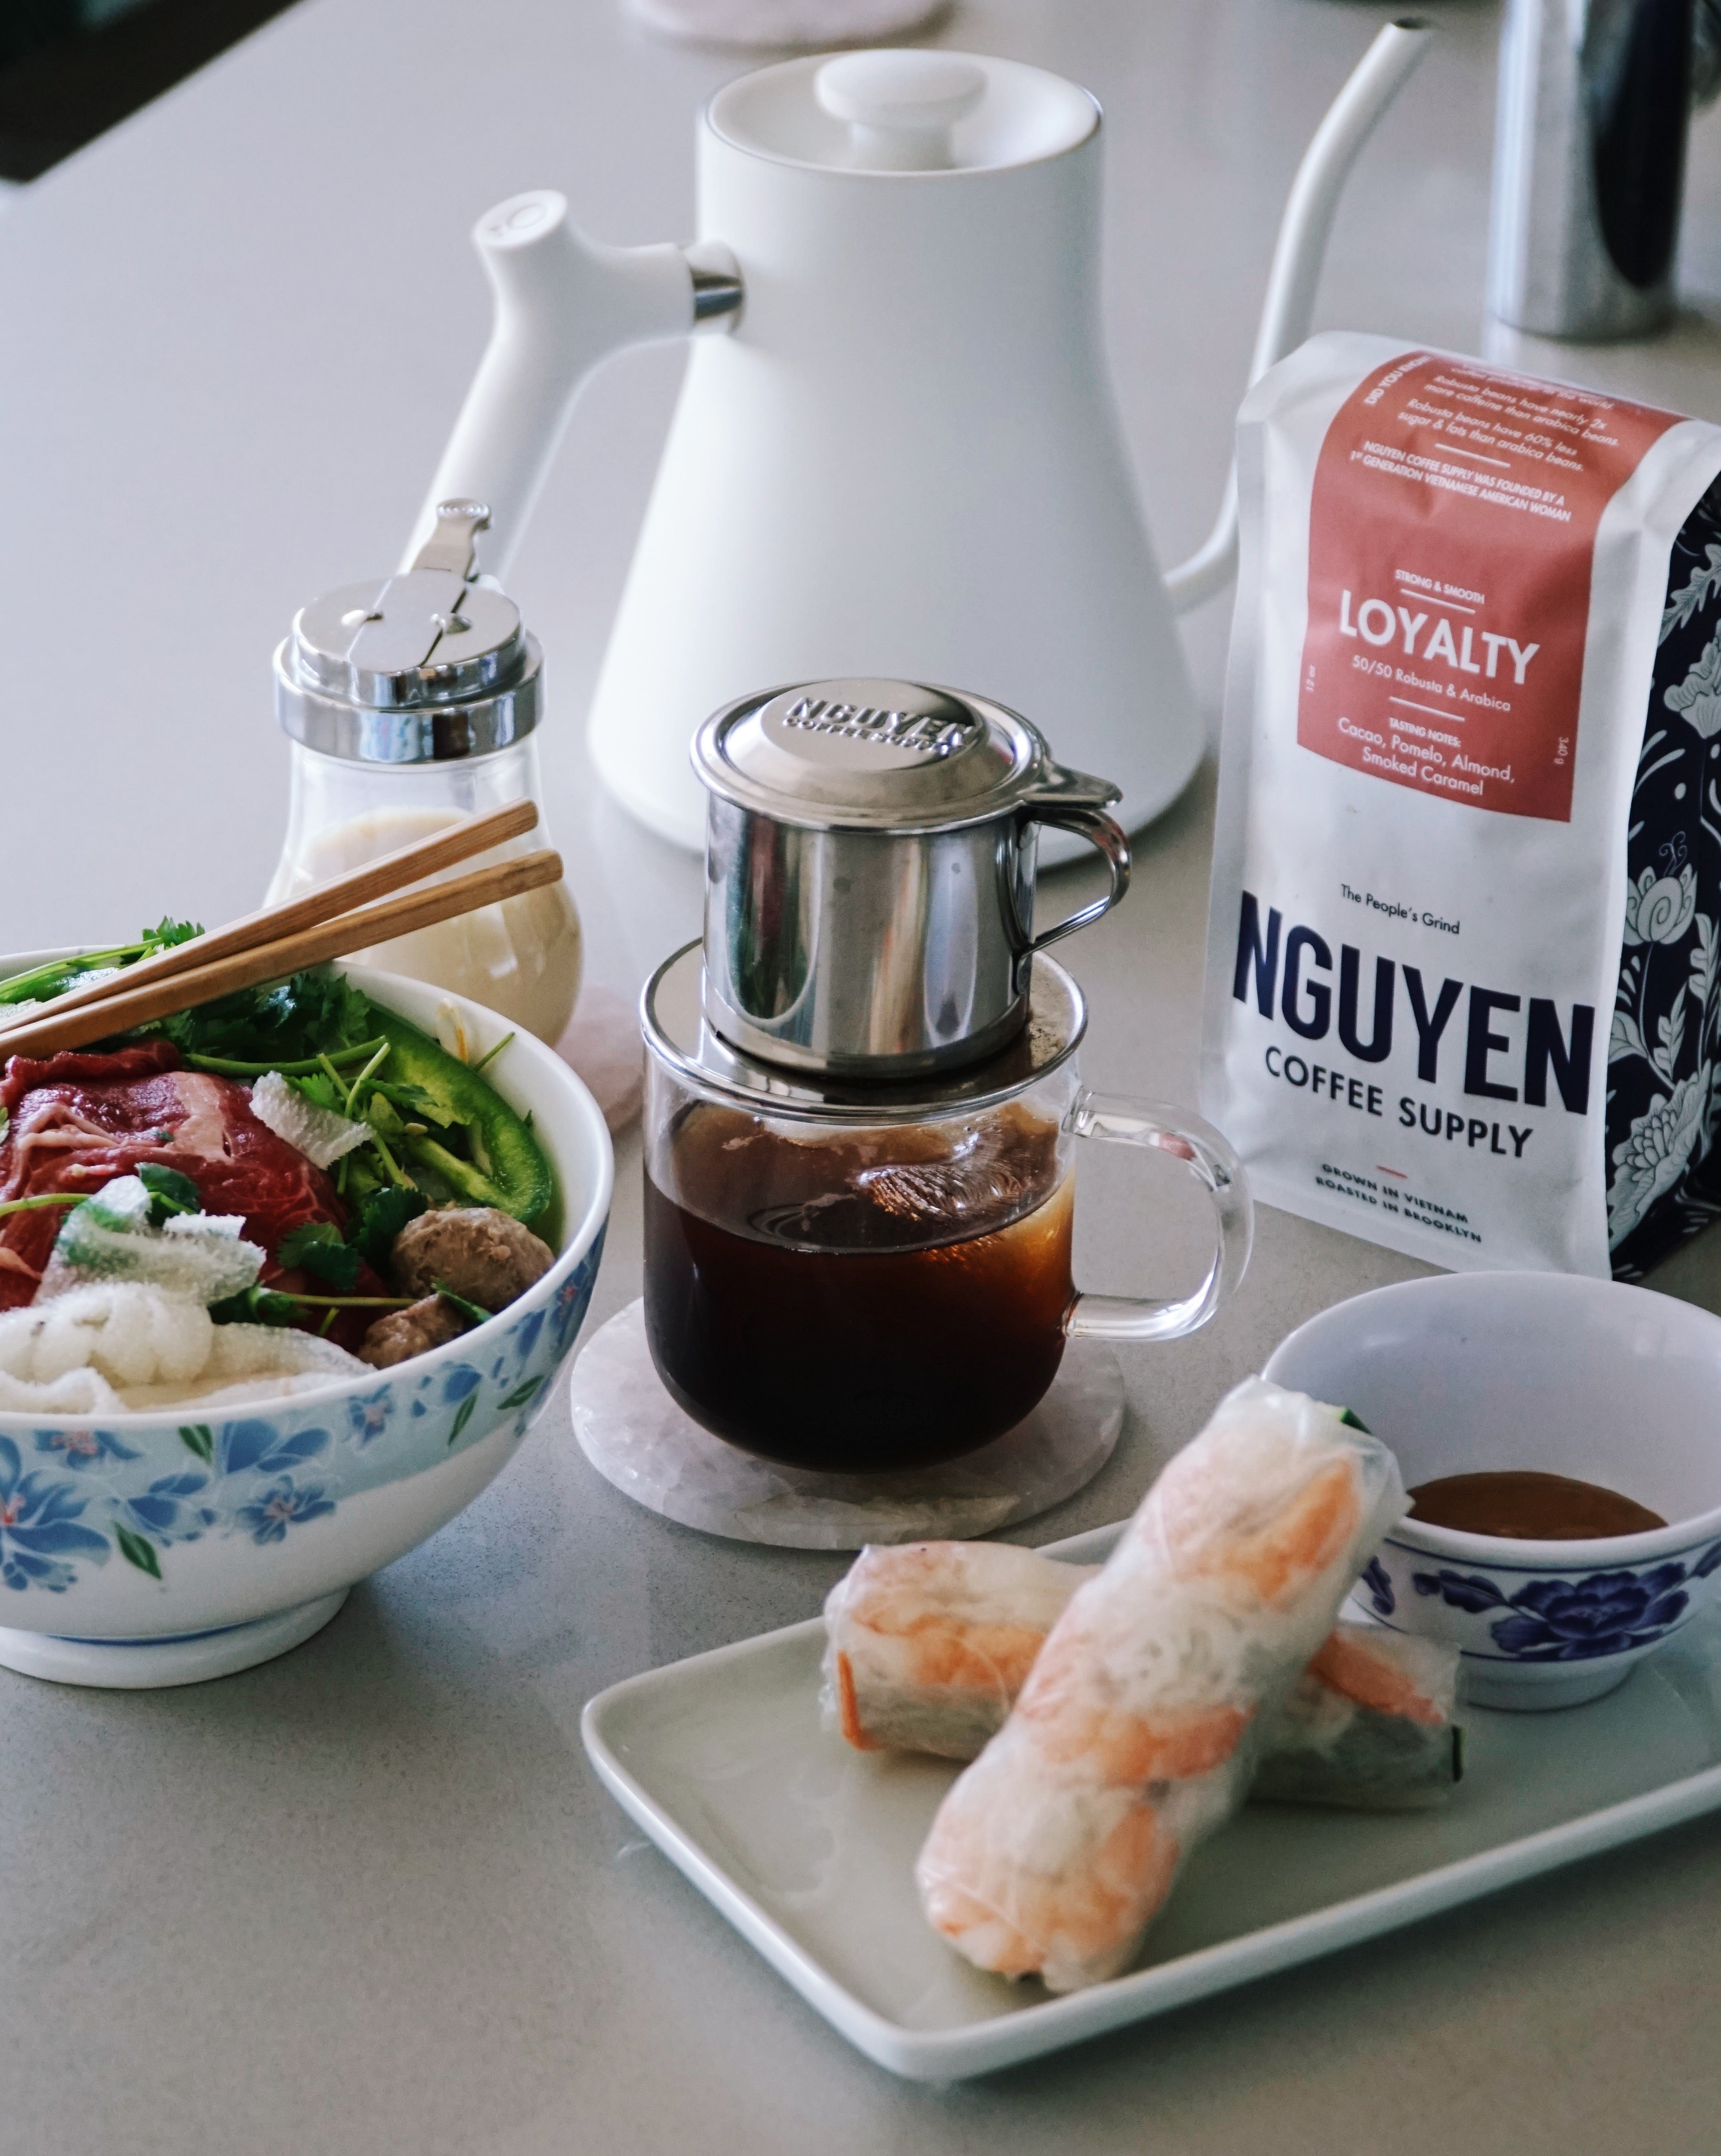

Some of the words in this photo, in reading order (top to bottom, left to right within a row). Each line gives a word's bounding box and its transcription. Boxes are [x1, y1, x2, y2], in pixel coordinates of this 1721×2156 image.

[1364, 388, 1384, 404] DID
[1378, 370, 1404, 388] YOU
[1424, 384, 1455, 397] more
[1456, 393, 1502, 412] caffeine
[1505, 406, 1531, 419] than
[1533, 415, 1580, 434] arabica
[1581, 429, 1619, 446] beans.
[1434, 375, 1479, 392] Robusta
[1482, 387, 1517, 403] beans
[1520, 398, 1549, 413] have
[1551, 409, 1588, 425] nearly
[1590, 418, 1607, 430] 2x
[1398, 412, 1432, 425] sugar
[1433, 418, 1445, 430] &
[1446, 422, 1467, 436] fats
[1469, 430, 1496, 444] than
[1498, 440, 1544, 459] arabica
[1546, 452, 1584, 471] beans.
[1407, 398, 1454, 419] Robusta
[1456, 412, 1491, 429] beans
[1493, 423, 1522, 439] have
[1524, 433, 1552, 448] 60%
[1555, 442, 1577, 456] less
[1363, 454, 1424, 481] GENERATION
[1425, 473, 1480, 497] VIETNAMESE
[1478, 488, 1530, 511] AMERICAN
[1530, 501, 1572, 522] WOMAN
[1364, 440, 1406, 462] NGUYEN
[1406, 454, 1441, 472] COFFEE
[1441, 463, 1474, 480] SUPPLY
[1474, 471, 1496, 487] WAS
[1496, 478, 1542, 499] FOUNDED
[1542, 491, 1558, 503] BY
[1555, 495, 1565, 506] A
[1395, 569, 1433, 590] STRONG
[1434, 581, 1442, 593] &
[1443, 583, 1486, 605] SMOOTH
[1340, 589, 1541, 685] LOYALTY
[1306, 678, 1315, 692] 12
[1352, 655, 1393, 679] 50/50
[1395, 667, 1443, 694] Robusta
[1446, 683, 1456, 698] &
[1460, 688, 1511, 712] Arabica
[785, 696, 974, 746] NGUYEN
[1389, 717, 1426, 737] TASTING
[1427, 729, 1461, 748] NOTES:
[1558, 737, 1569, 756] 340
[1338, 717, 1387, 749] Cacao,
[1391, 734, 1447, 768] Pomelo,
[1451, 753, 1515, 784] Almond,
[1362, 746, 1418, 778] Smoked
[1420, 765, 1484, 796] Caramel
[1341, 883, 1362, 903] The
[1365, 893, 1418, 918] People's
[1422, 912, 1460, 935] Grind
[1233, 889, 1596, 1116] NGUYEN
[1265, 1046, 1383, 1117] COFFEE
[1398, 1096, 1534, 1158] SUPPLY
[1316, 1176, 1377, 1204] ROASTED
[1383, 1201, 1399, 1213] IN
[1404, 1207, 1482, 1243] BROOKLYN
[1322, 1163, 1377, 1191] GROWN
[1383, 1186, 1399, 1198] IN
[1404, 1193, 1468, 1223] VIETNAM
